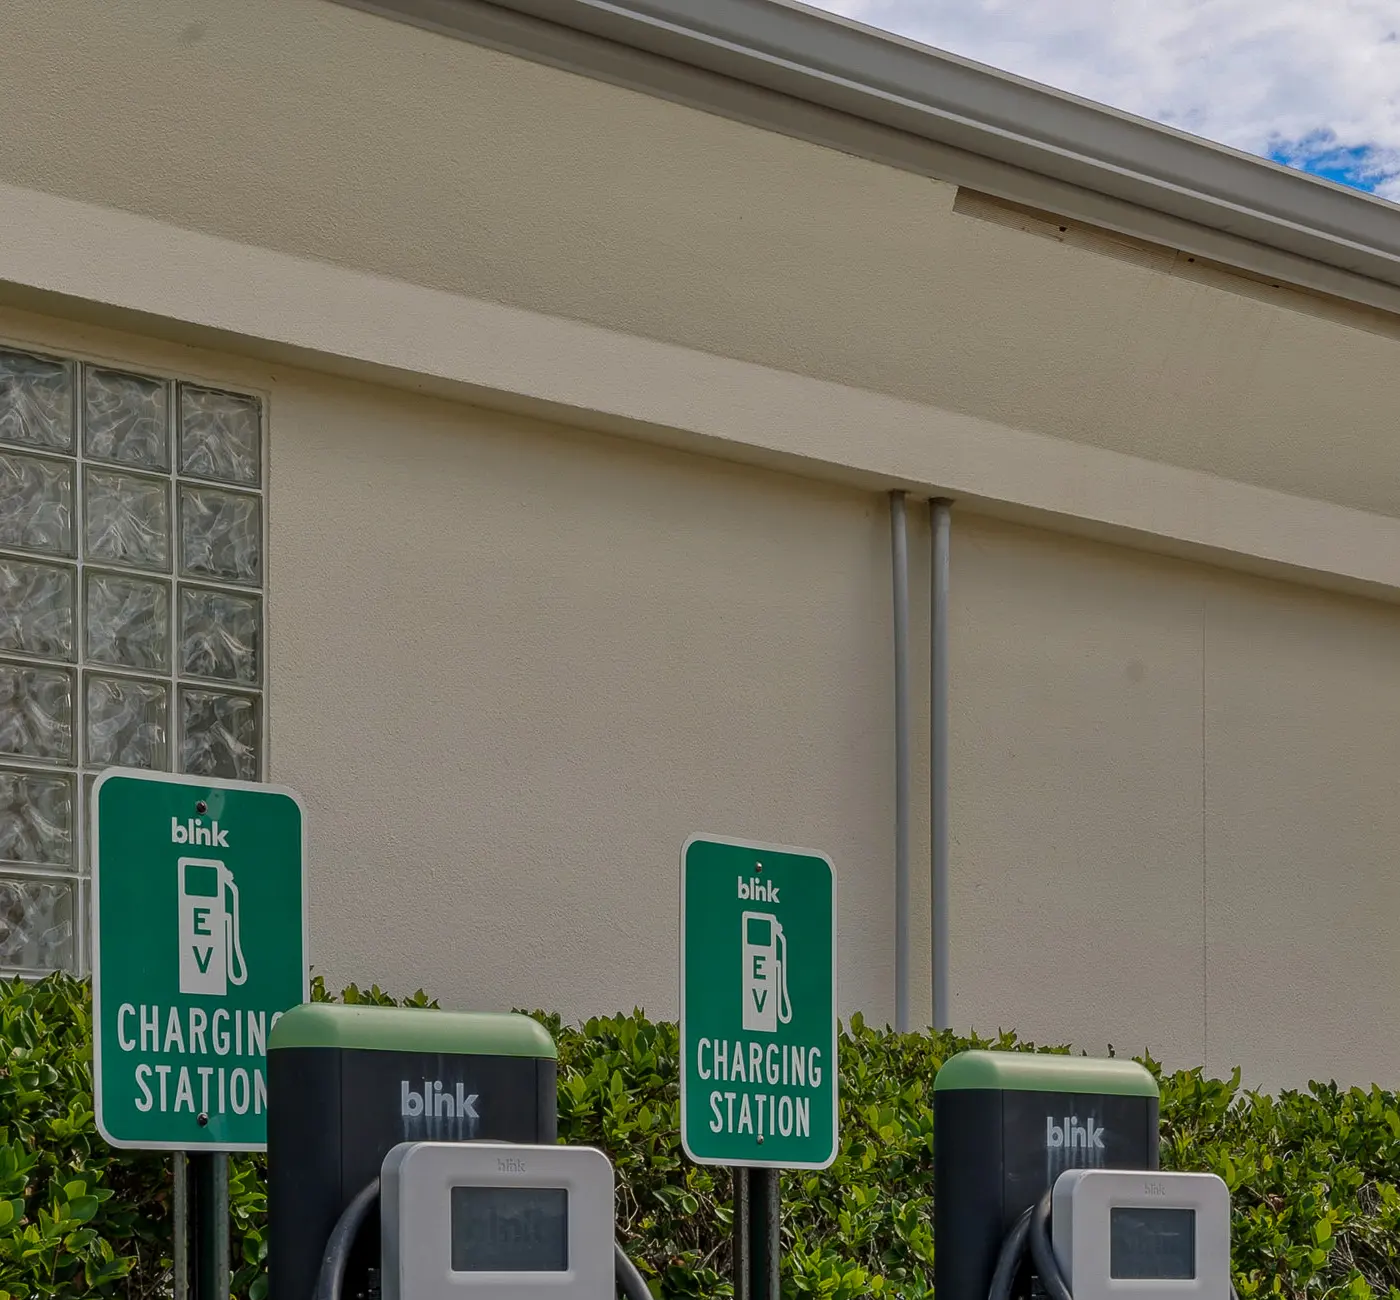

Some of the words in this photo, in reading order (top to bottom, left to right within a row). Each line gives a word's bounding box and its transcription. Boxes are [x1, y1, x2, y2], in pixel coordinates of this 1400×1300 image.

[171, 817, 230, 848] blink
[737, 875, 780, 904] blink
[117, 1002, 284, 1057] CHARGIN
[697, 1037, 822, 1088] CHARGING
[400, 1080, 480, 1119] blink
[709, 1090, 810, 1137] STATION
[1046, 1116, 1105, 1149] blink
[497, 1157, 526, 1173] blink
